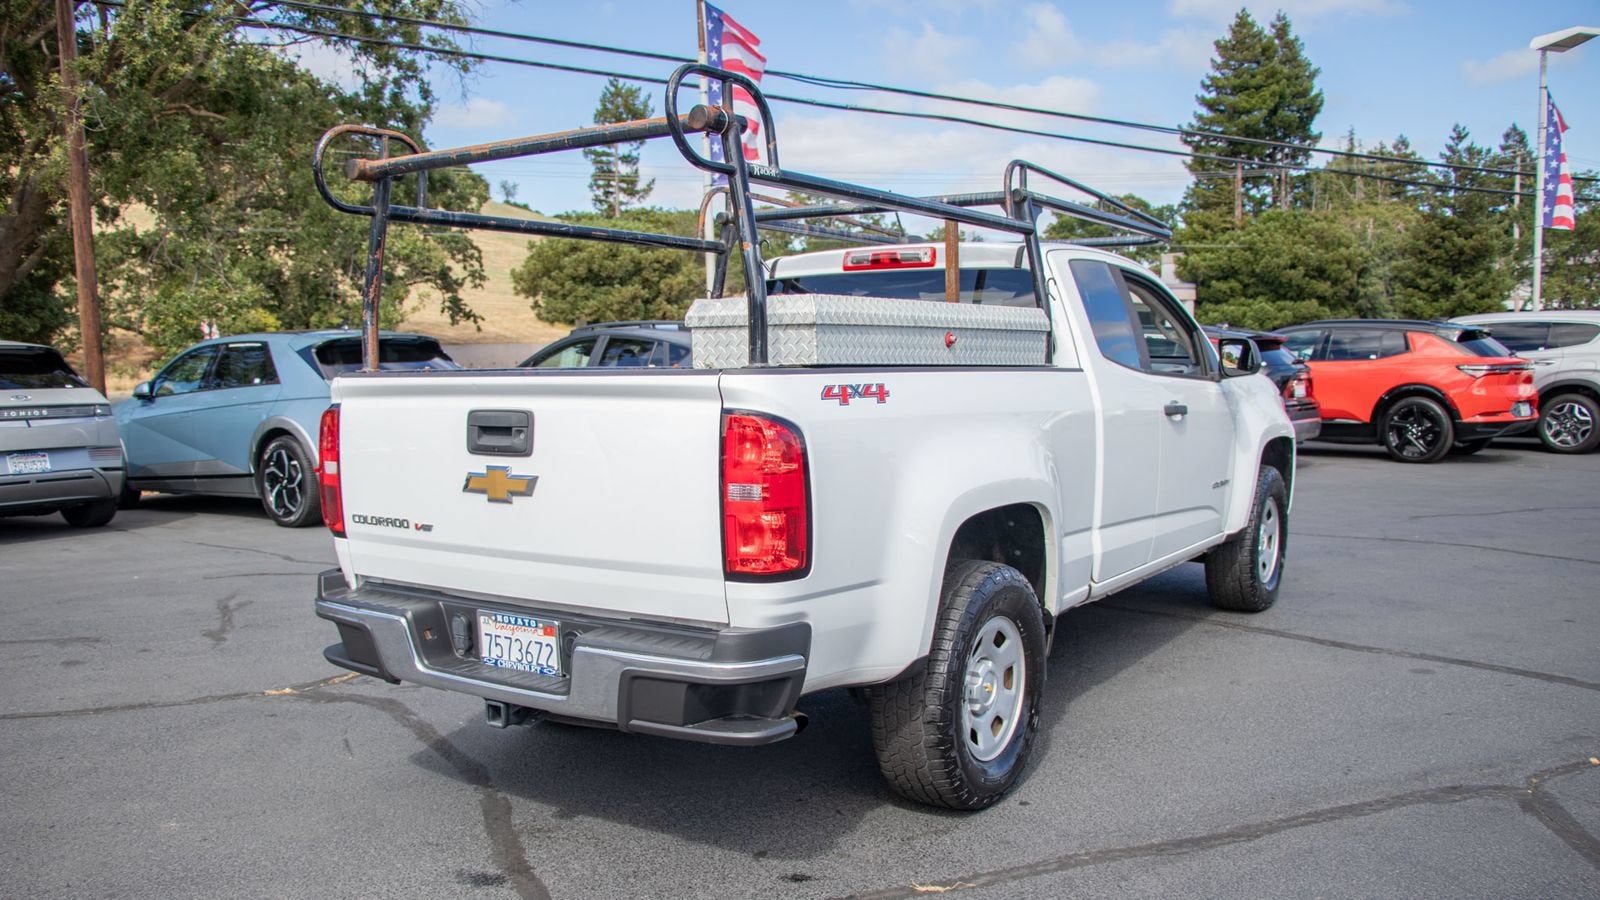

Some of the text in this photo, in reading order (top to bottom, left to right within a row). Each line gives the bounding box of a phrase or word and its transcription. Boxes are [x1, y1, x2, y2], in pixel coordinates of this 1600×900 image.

[352, 514, 410, 529] COLORADO
[496, 614, 537, 628] NOVATO
[497, 659, 542, 674] CHEVROLET
